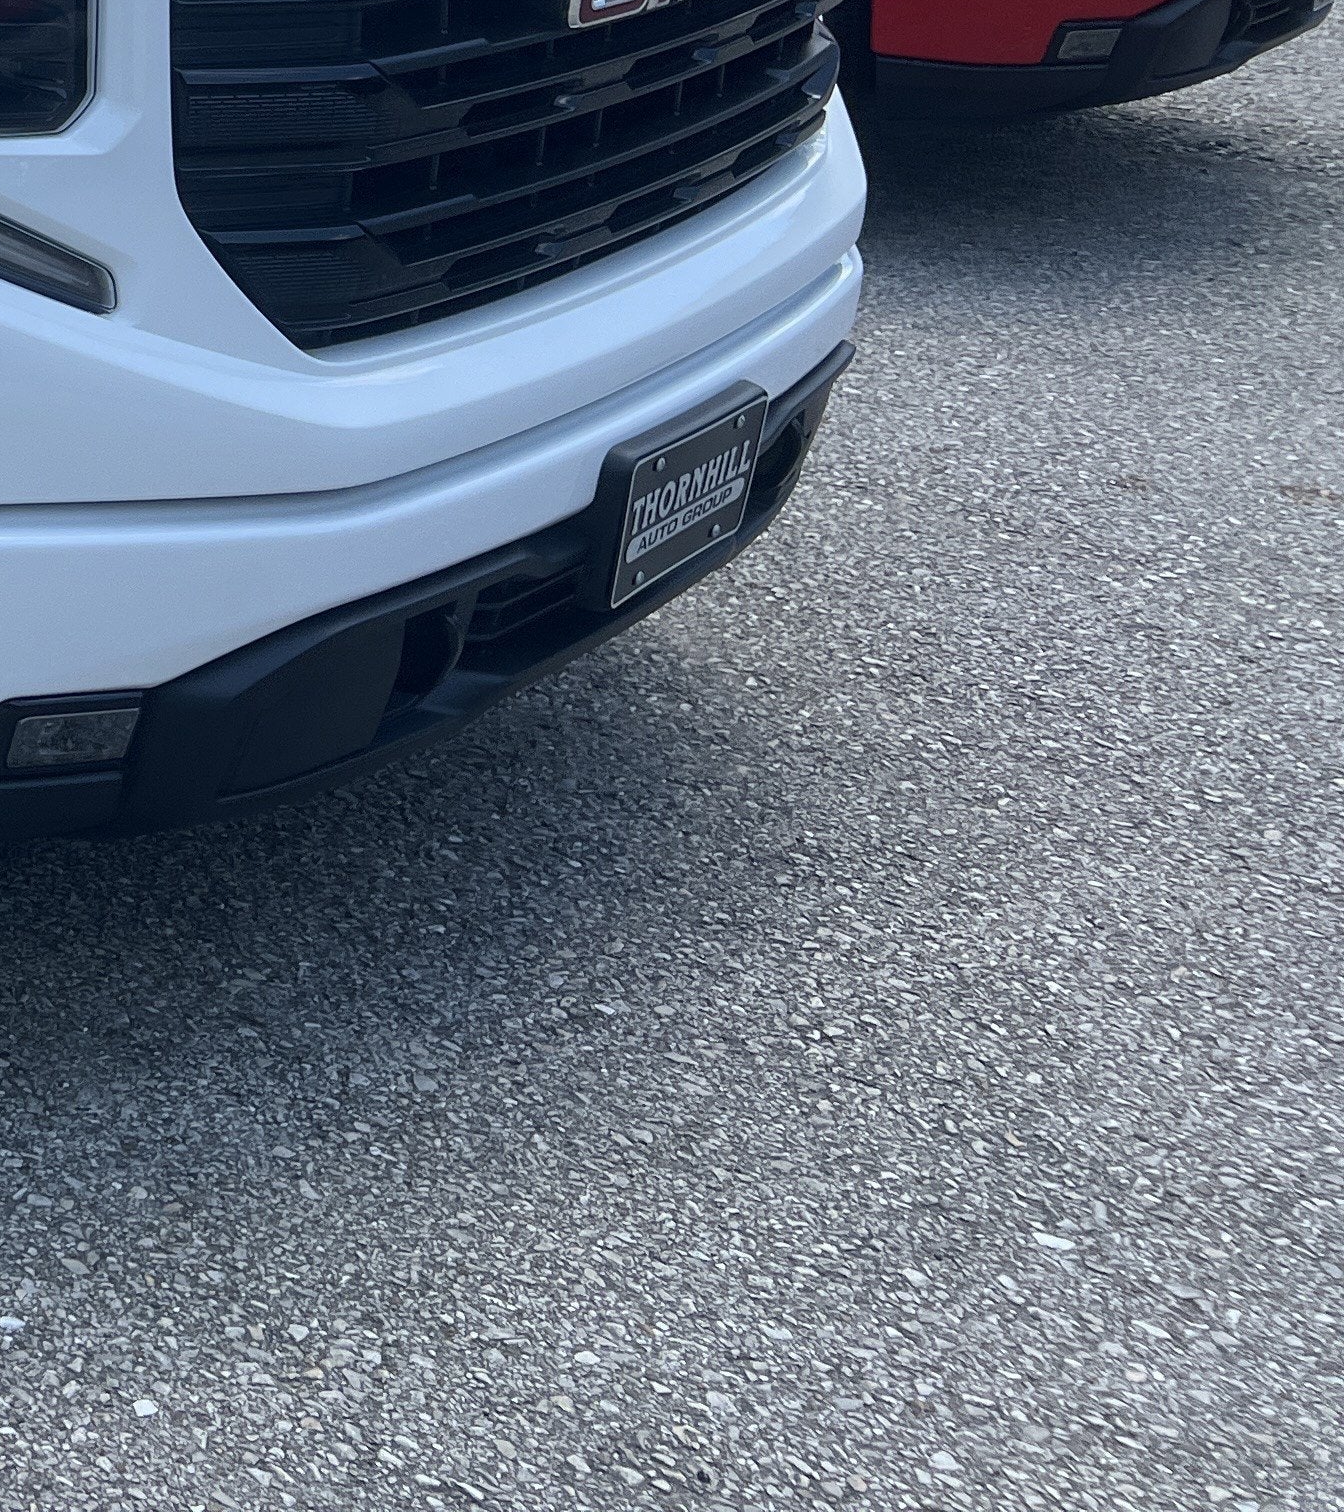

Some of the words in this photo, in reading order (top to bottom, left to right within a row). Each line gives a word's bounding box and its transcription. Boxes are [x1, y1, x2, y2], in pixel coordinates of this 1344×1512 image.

[631, 440, 751, 536] THORNHILL
[637, 519, 678, 554] AUTO
[682, 486, 733, 527] GROUP
